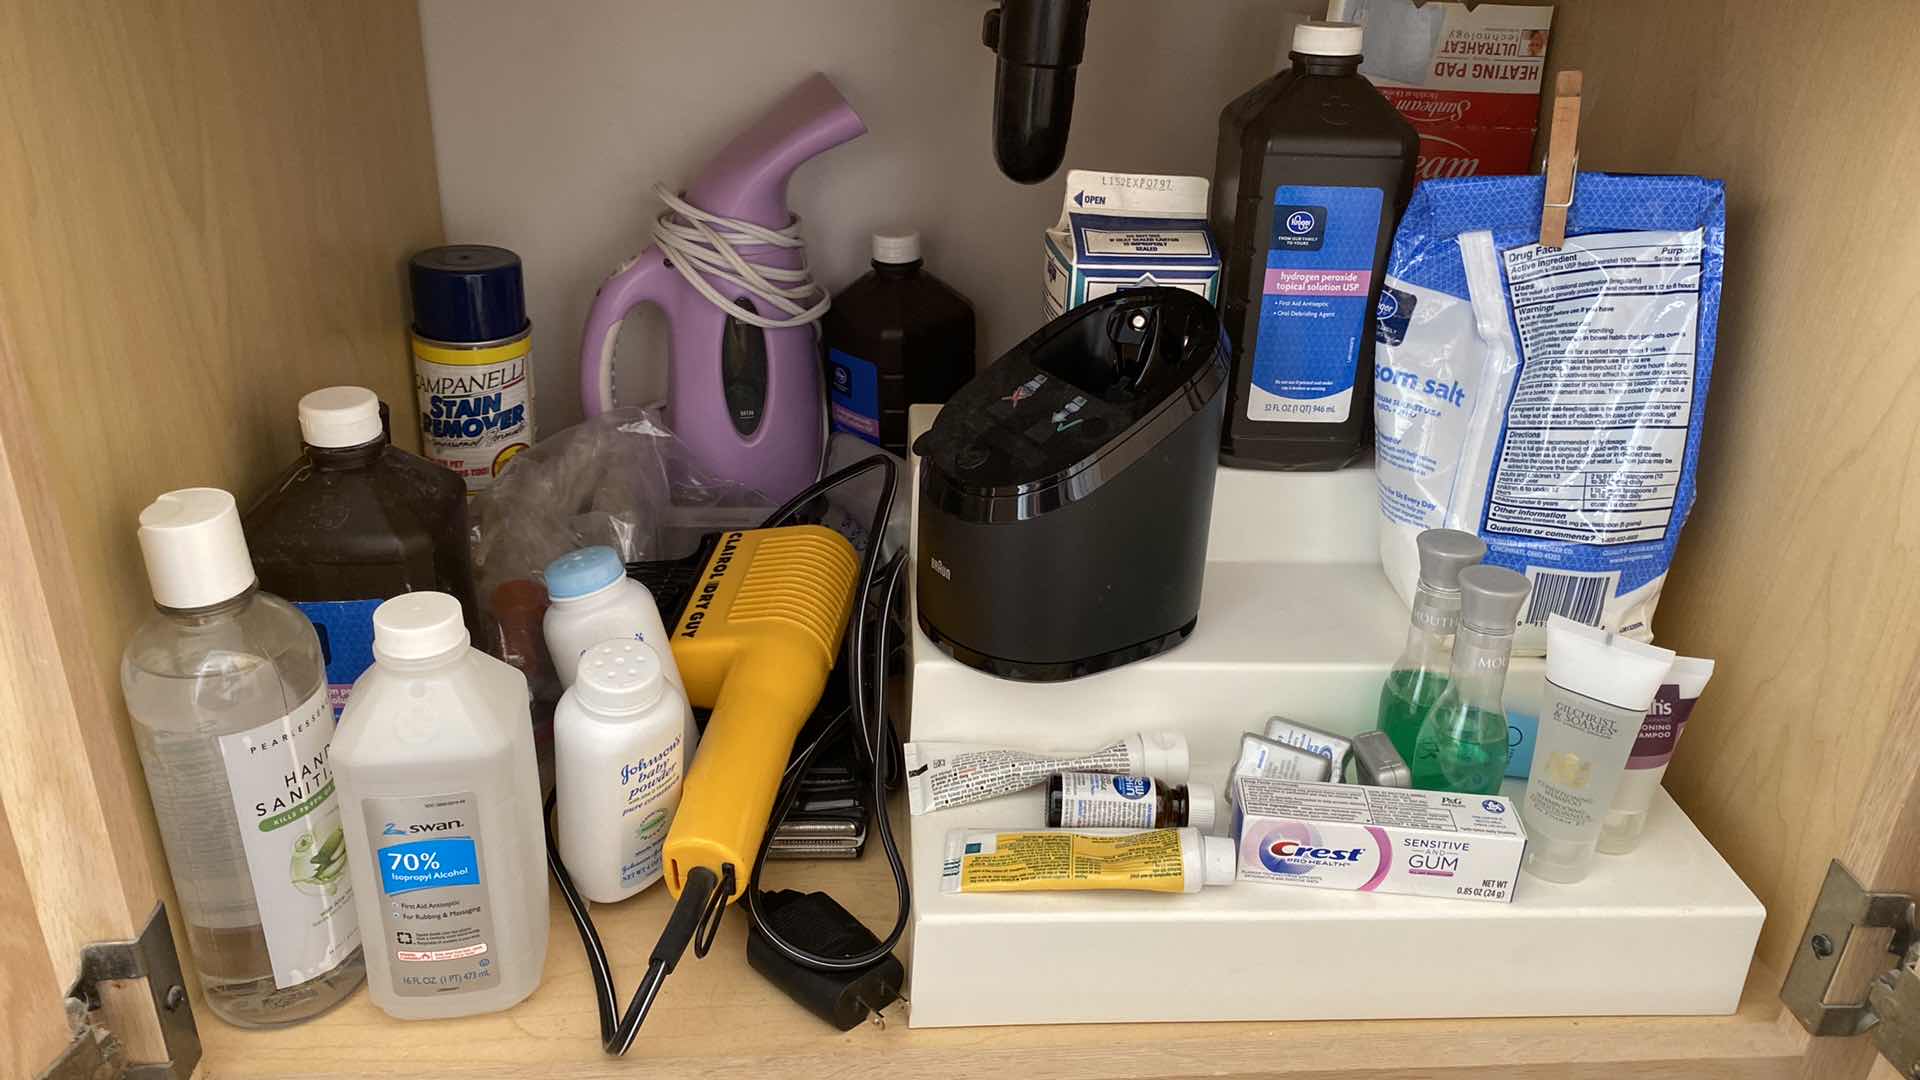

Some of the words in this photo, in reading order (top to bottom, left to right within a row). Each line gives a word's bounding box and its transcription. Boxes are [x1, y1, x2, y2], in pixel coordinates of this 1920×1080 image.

[1448, 30, 1519, 43] technology
[1440, 40, 1517, 57] ULTRAHEAT
[1434, 61, 1468, 79] PAD
[1473, 64, 1539, 81] HEATING
[1395, 99, 1472, 120] Sunbeam
[1084, 195, 1106, 205] OPEN
[1509, 250, 1533, 262] Drug
[1536, 246, 1562, 256] Facts
[1511, 262, 1536, 273] Active
[1280, 271, 1320, 283] hydrogen
[1321, 272, 1358, 284] peroxide
[1276, 282, 1305, 293] topical
[1305, 283, 1341, 292] solution
[1342, 283, 1360, 292] USP
[1515, 283, 1535, 291] Uses
[1519, 305, 1554, 315] Warnings
[1423, 379, 1465, 407] salt
[430, 392, 502, 419] STAIN
[422, 404, 525, 438] REMOVER
[1493, 505, 1518, 514] Other
[1518, 508, 1567, 520] information
[1490, 523, 1532, 534] Questions
[1545, 531, 1596, 542] comments?
[709, 532, 744, 580] CLAIROL
[931, 557, 951, 581] BRAUN
[695, 580, 720, 610] DRY
[681, 611, 705, 638] GUY
[1555, 702, 1617, 727] GILCHRIST
[638, 758, 670, 784] baby
[628, 762, 677, 801] powder
[256, 767, 334, 817] SANITI
[1441, 796, 1462, 805] P&G
[1270, 841, 1364, 862] Crest
[1403, 838, 1470, 851] SENSITIVE
[1425, 848, 1445, 857] AND
[387, 851, 440, 871] 70%
[1408, 854, 1459, 871] GUM
[391, 872, 432, 882] Isopropyl
[433, 867, 468, 880] Alcohol
[1456, 886, 1472, 896] 0.85
[1484, 888, 1496, 898] (24
[1482, 879, 1496, 888] NET
[1497, 880, 1508, 889] WT
[463, 971, 476, 980] 473
